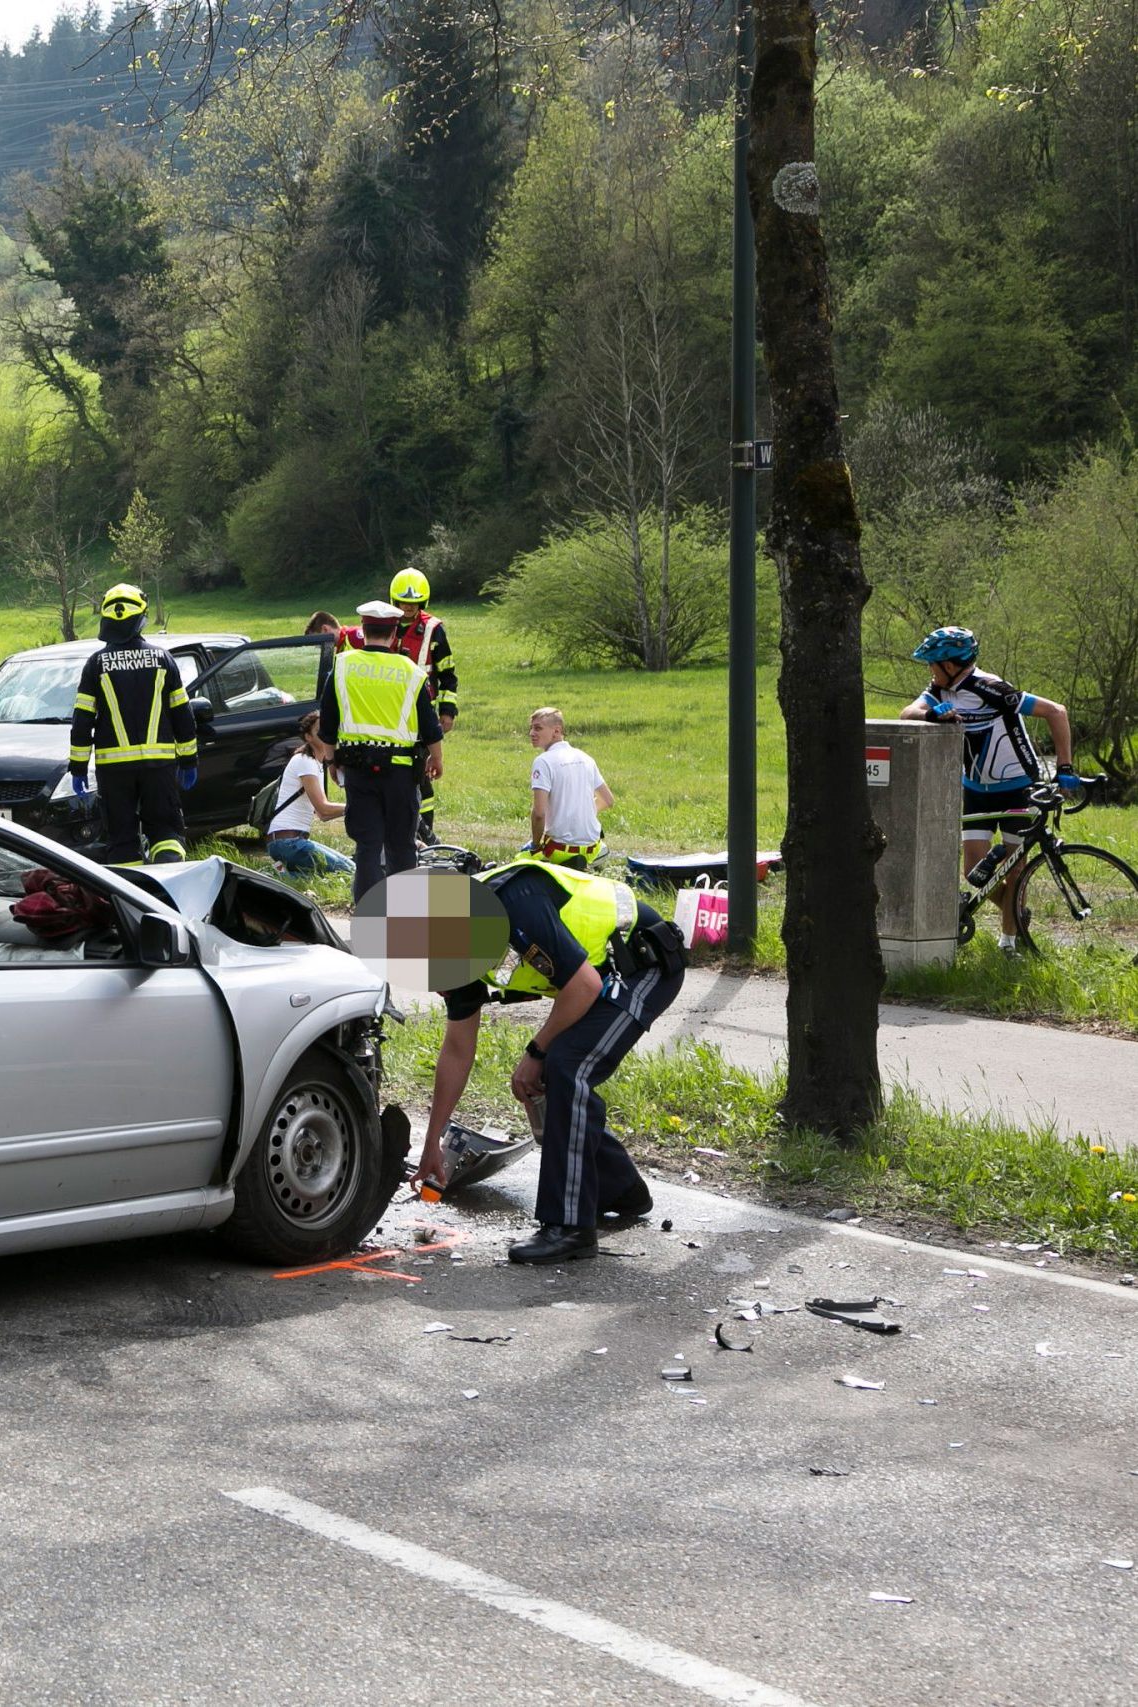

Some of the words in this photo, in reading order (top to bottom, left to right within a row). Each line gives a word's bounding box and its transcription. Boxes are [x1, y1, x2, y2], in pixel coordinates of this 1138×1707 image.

[102, 657, 162, 673] RANKWEIL
[968, 843, 1025, 904] MERIDA
[698, 909, 729, 931] BIP
